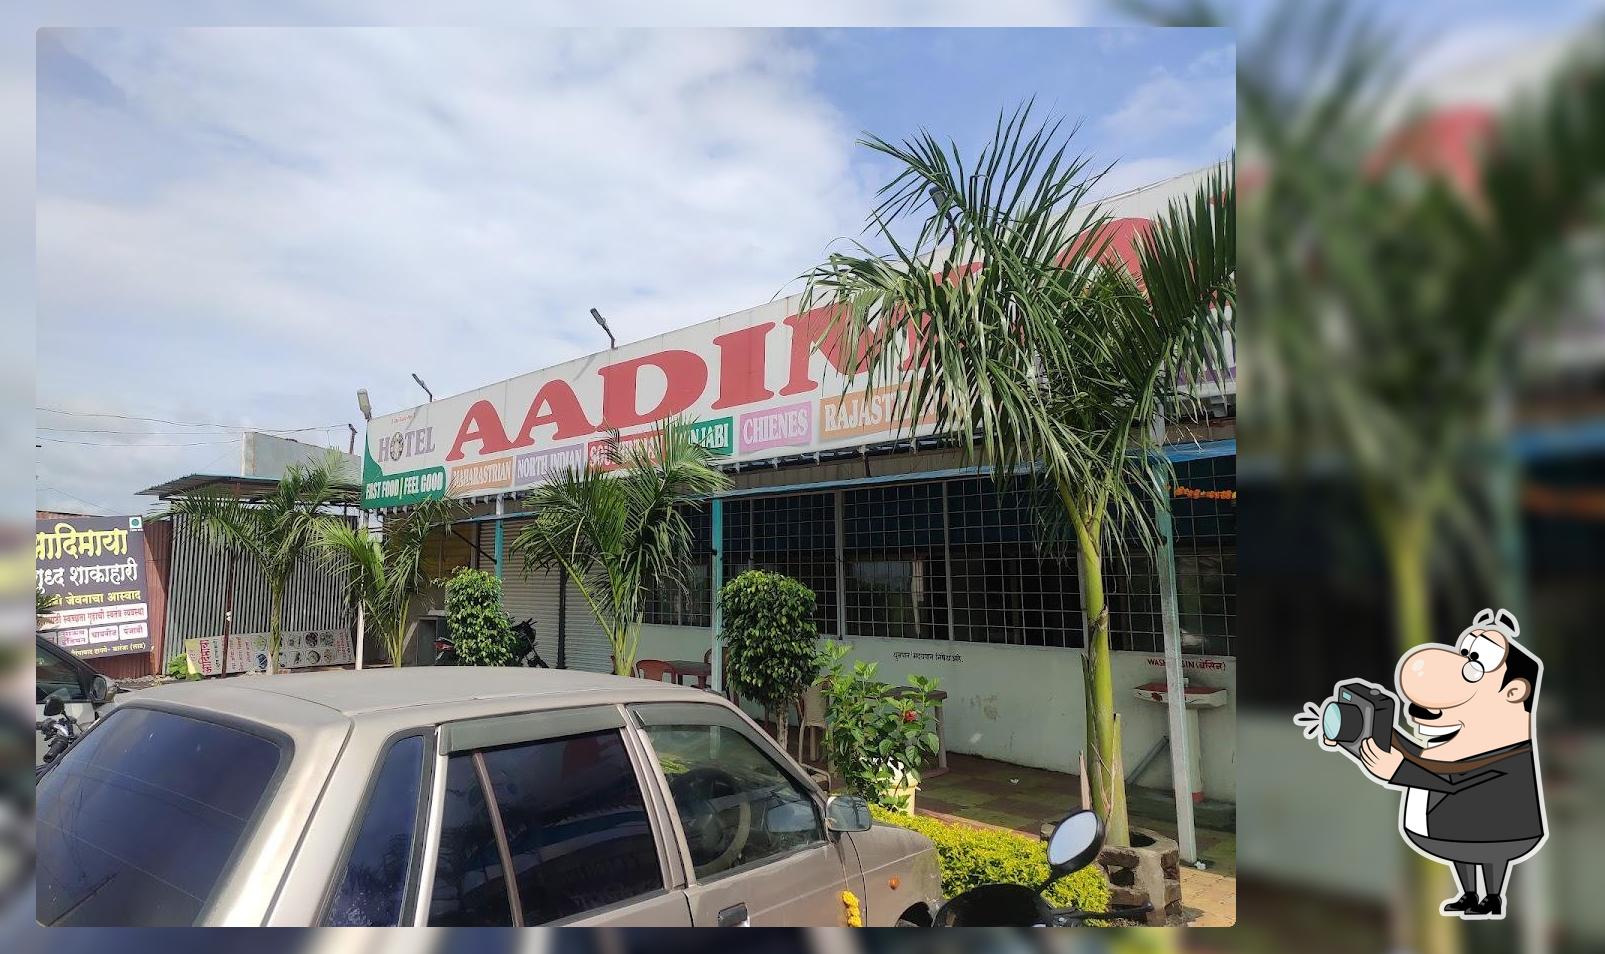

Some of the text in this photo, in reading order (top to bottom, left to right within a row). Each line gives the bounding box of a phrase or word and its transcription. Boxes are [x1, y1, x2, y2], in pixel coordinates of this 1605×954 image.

[823, 387, 938, 432] RAJAST
[678, 423, 729, 449] NJABI
[743, 408, 809, 445] CHIENES
[378, 427, 436, 463] HOTEL
[590, 442, 623, 467] SOU
[517, 449, 583, 478] NORTH INDIAN
[366, 472, 443, 500] FAST FOOD FEEL GOOD
[70, 557, 138, 586] शाकाहारी
